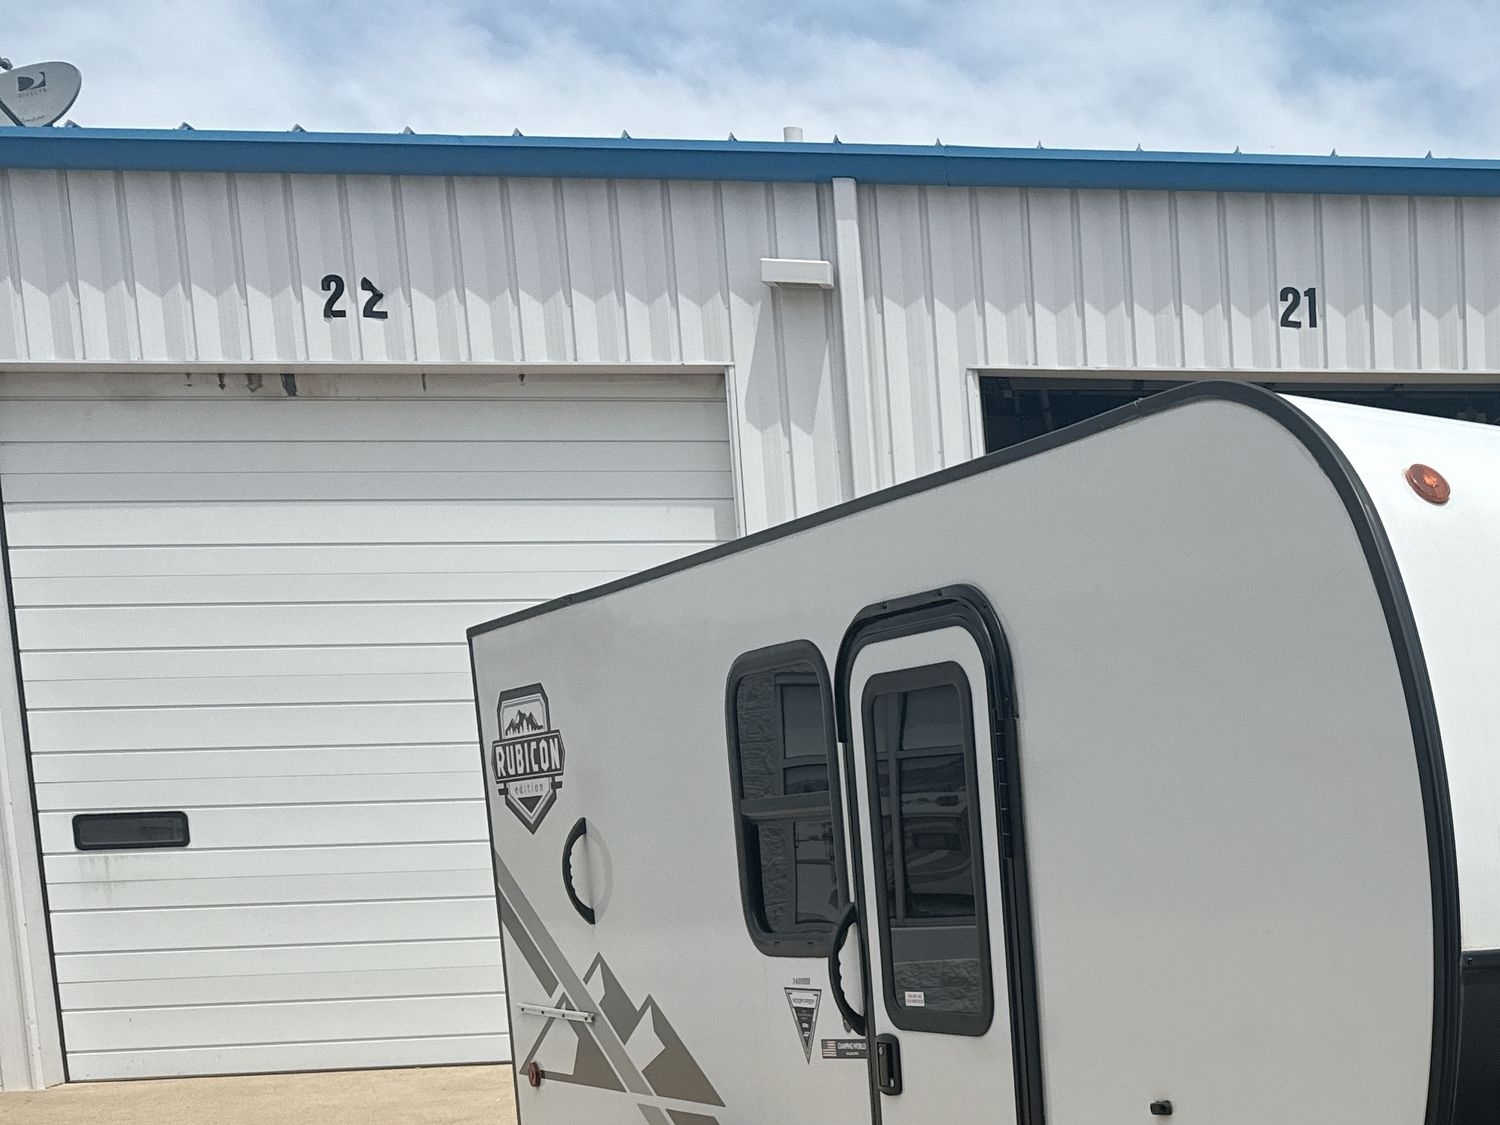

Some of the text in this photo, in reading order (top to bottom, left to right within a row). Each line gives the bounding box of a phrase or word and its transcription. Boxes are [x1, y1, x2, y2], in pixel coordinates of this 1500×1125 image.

[321, 274, 388, 319] 22
[1280, 287, 1317, 328] 21
[495, 737, 561, 777] RUBICON
[514, 783, 544, 795] edition
